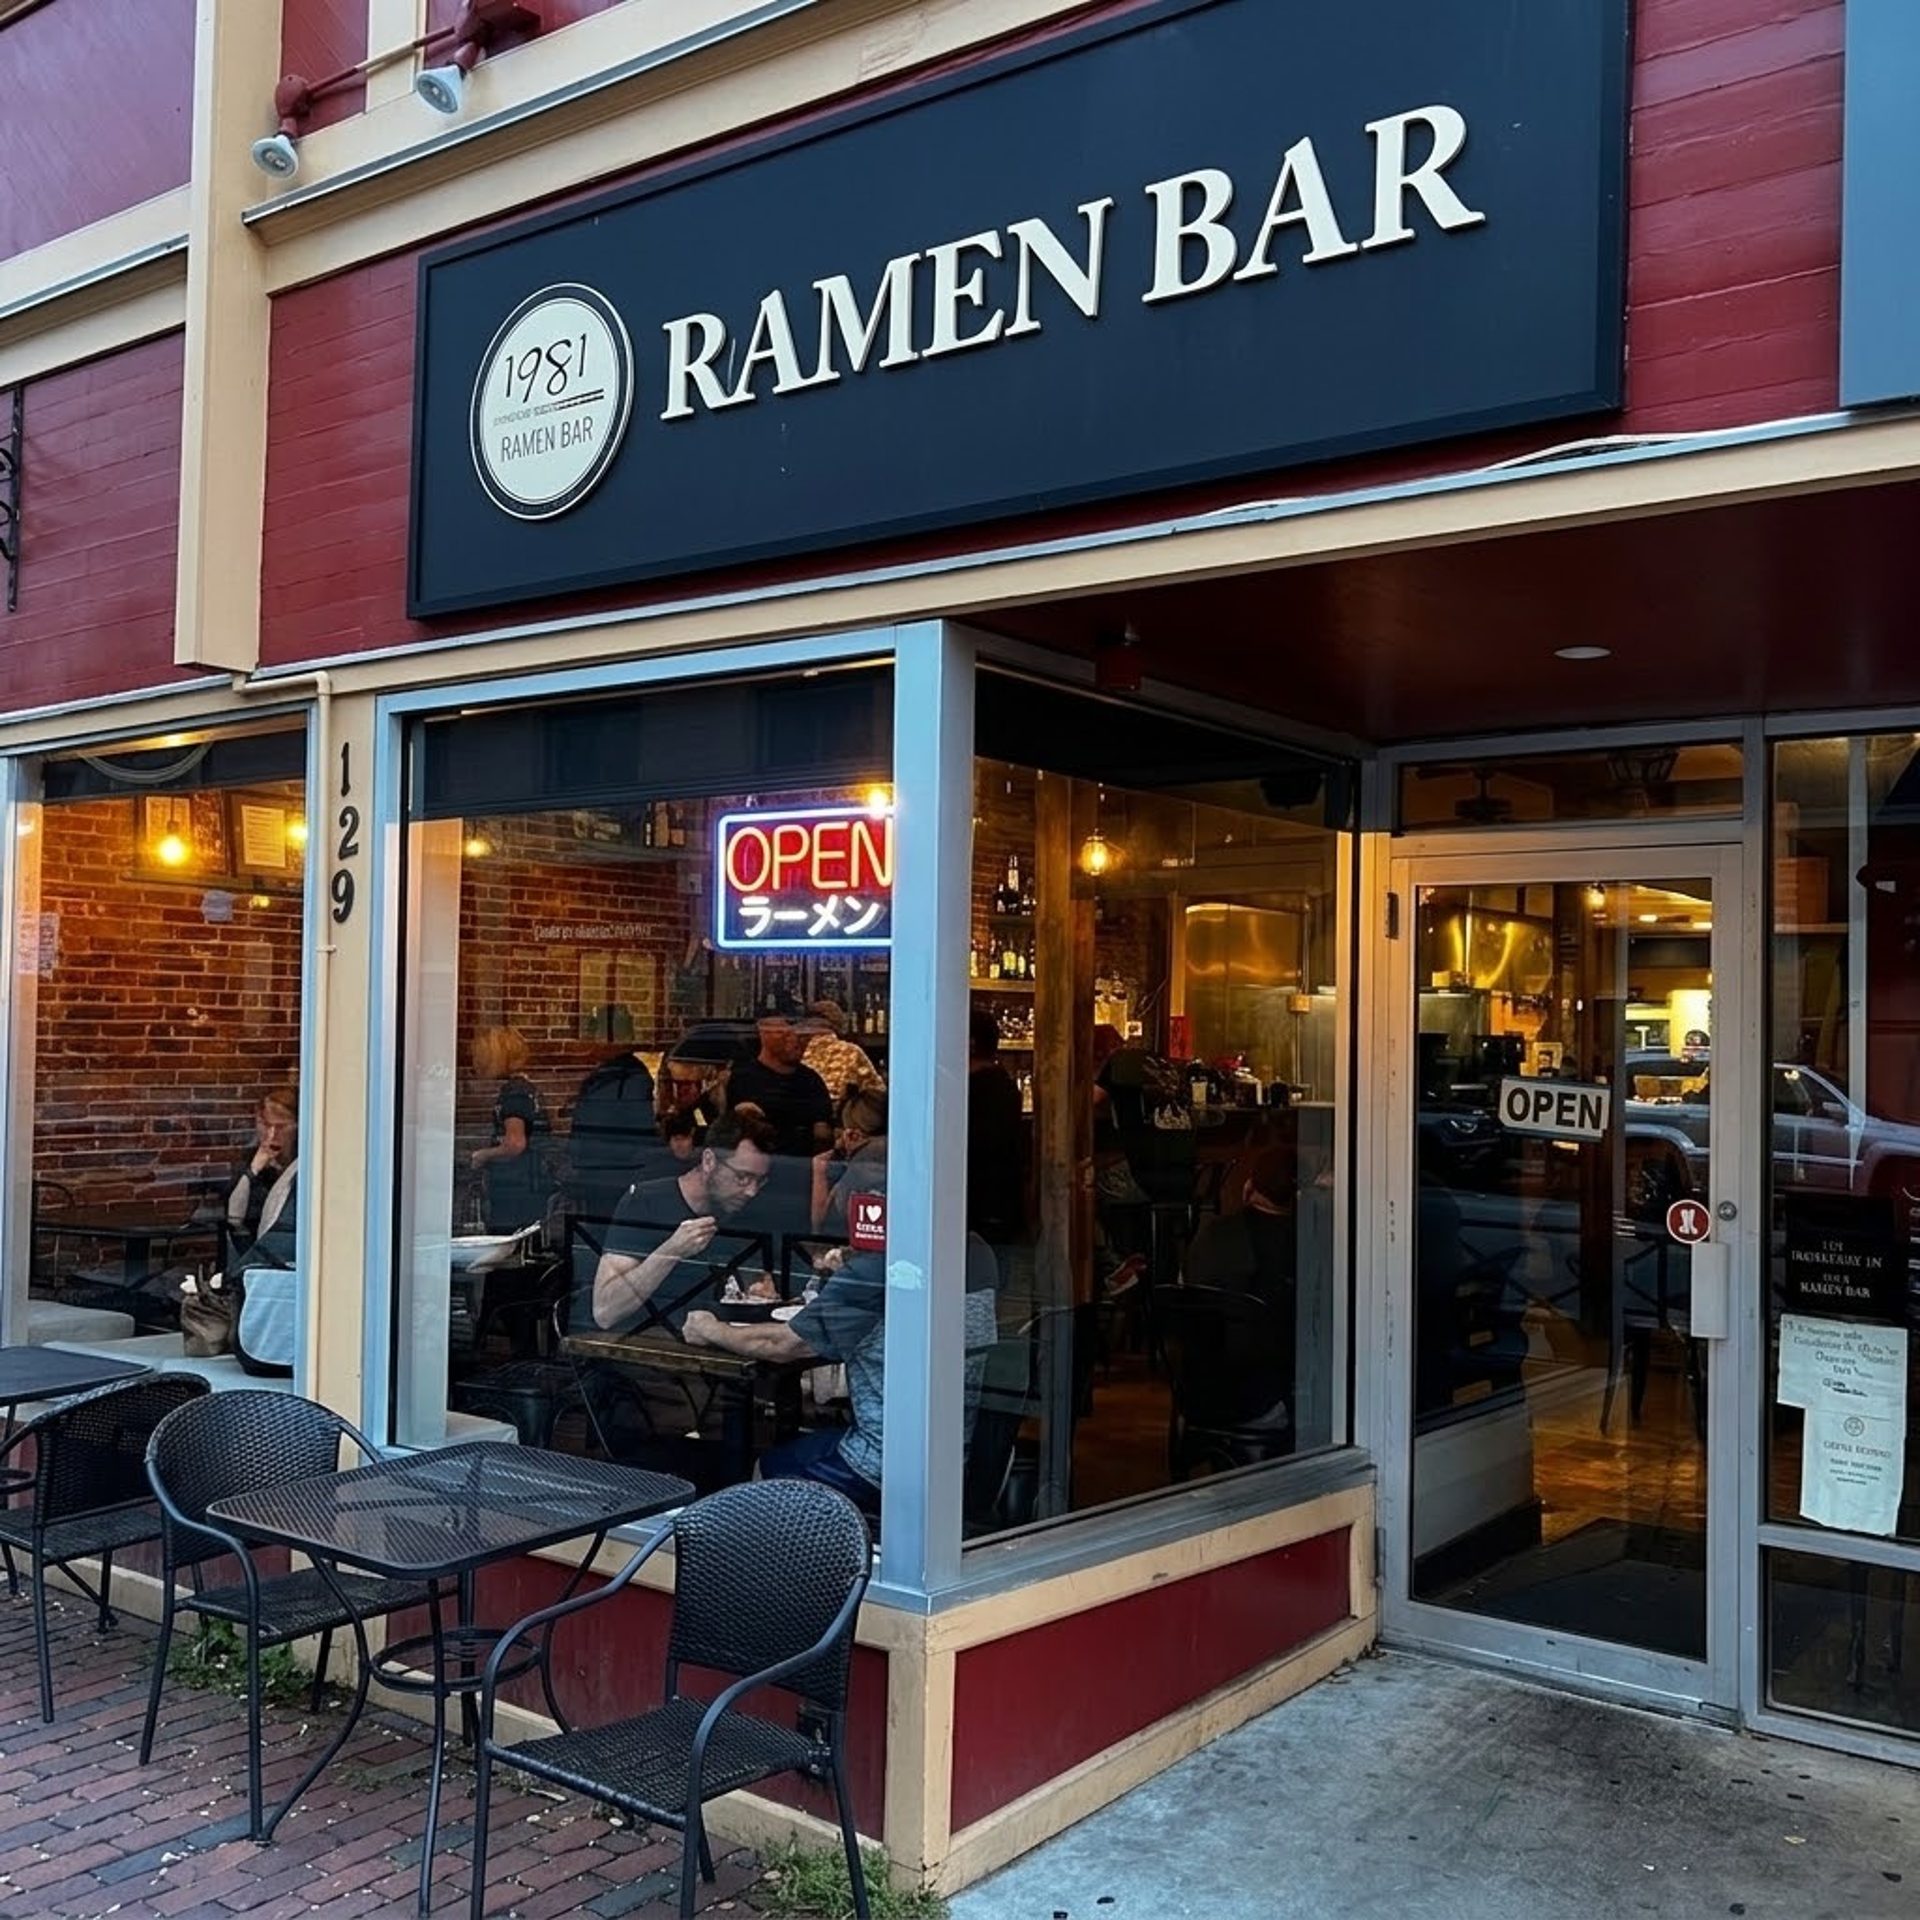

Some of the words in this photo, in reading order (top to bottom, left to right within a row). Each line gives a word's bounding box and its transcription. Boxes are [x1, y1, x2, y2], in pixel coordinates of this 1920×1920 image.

[660, 196, 1114, 421] RAMEN
[1142, 104, 1486, 303] BAR
[504, 333, 587, 403] 1981
[501, 424, 556, 462] RAMEN
[560, 416, 594, 448] BAR
[332, 742, 360, 924] 129
[727, 816, 894, 892] OPEN
[738, 895, 882, 938] ラーメン
[1507, 1087, 1603, 1130] OPEN
